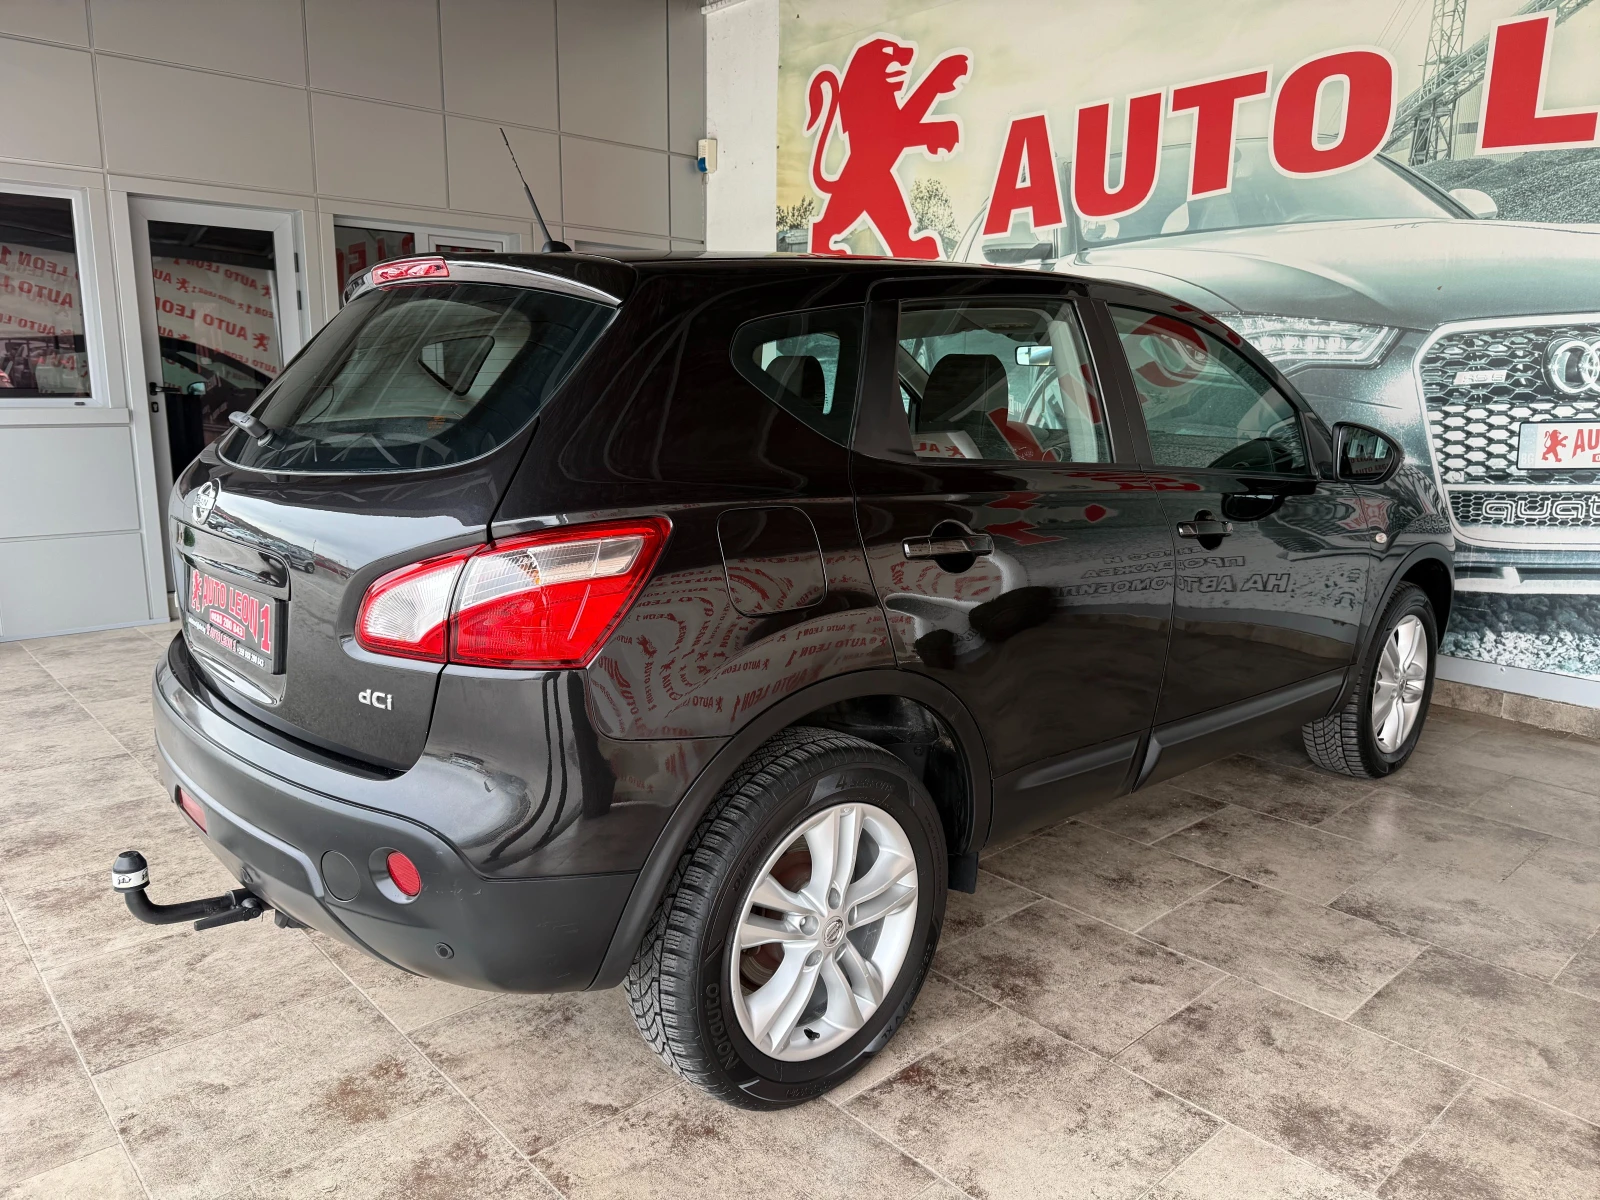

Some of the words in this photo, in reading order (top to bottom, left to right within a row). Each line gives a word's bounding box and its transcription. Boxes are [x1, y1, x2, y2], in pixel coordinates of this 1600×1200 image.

[981, 47, 1394, 236] AUTO
[202, 573, 227, 613] AUTO
[229, 587, 259, 644] LEON
[260, 603, 272, 654] 1
[357, 688, 394, 711] dCi
[731, 830, 776, 893] OUTSIDE
[704, 981, 740, 1071] Norauto
